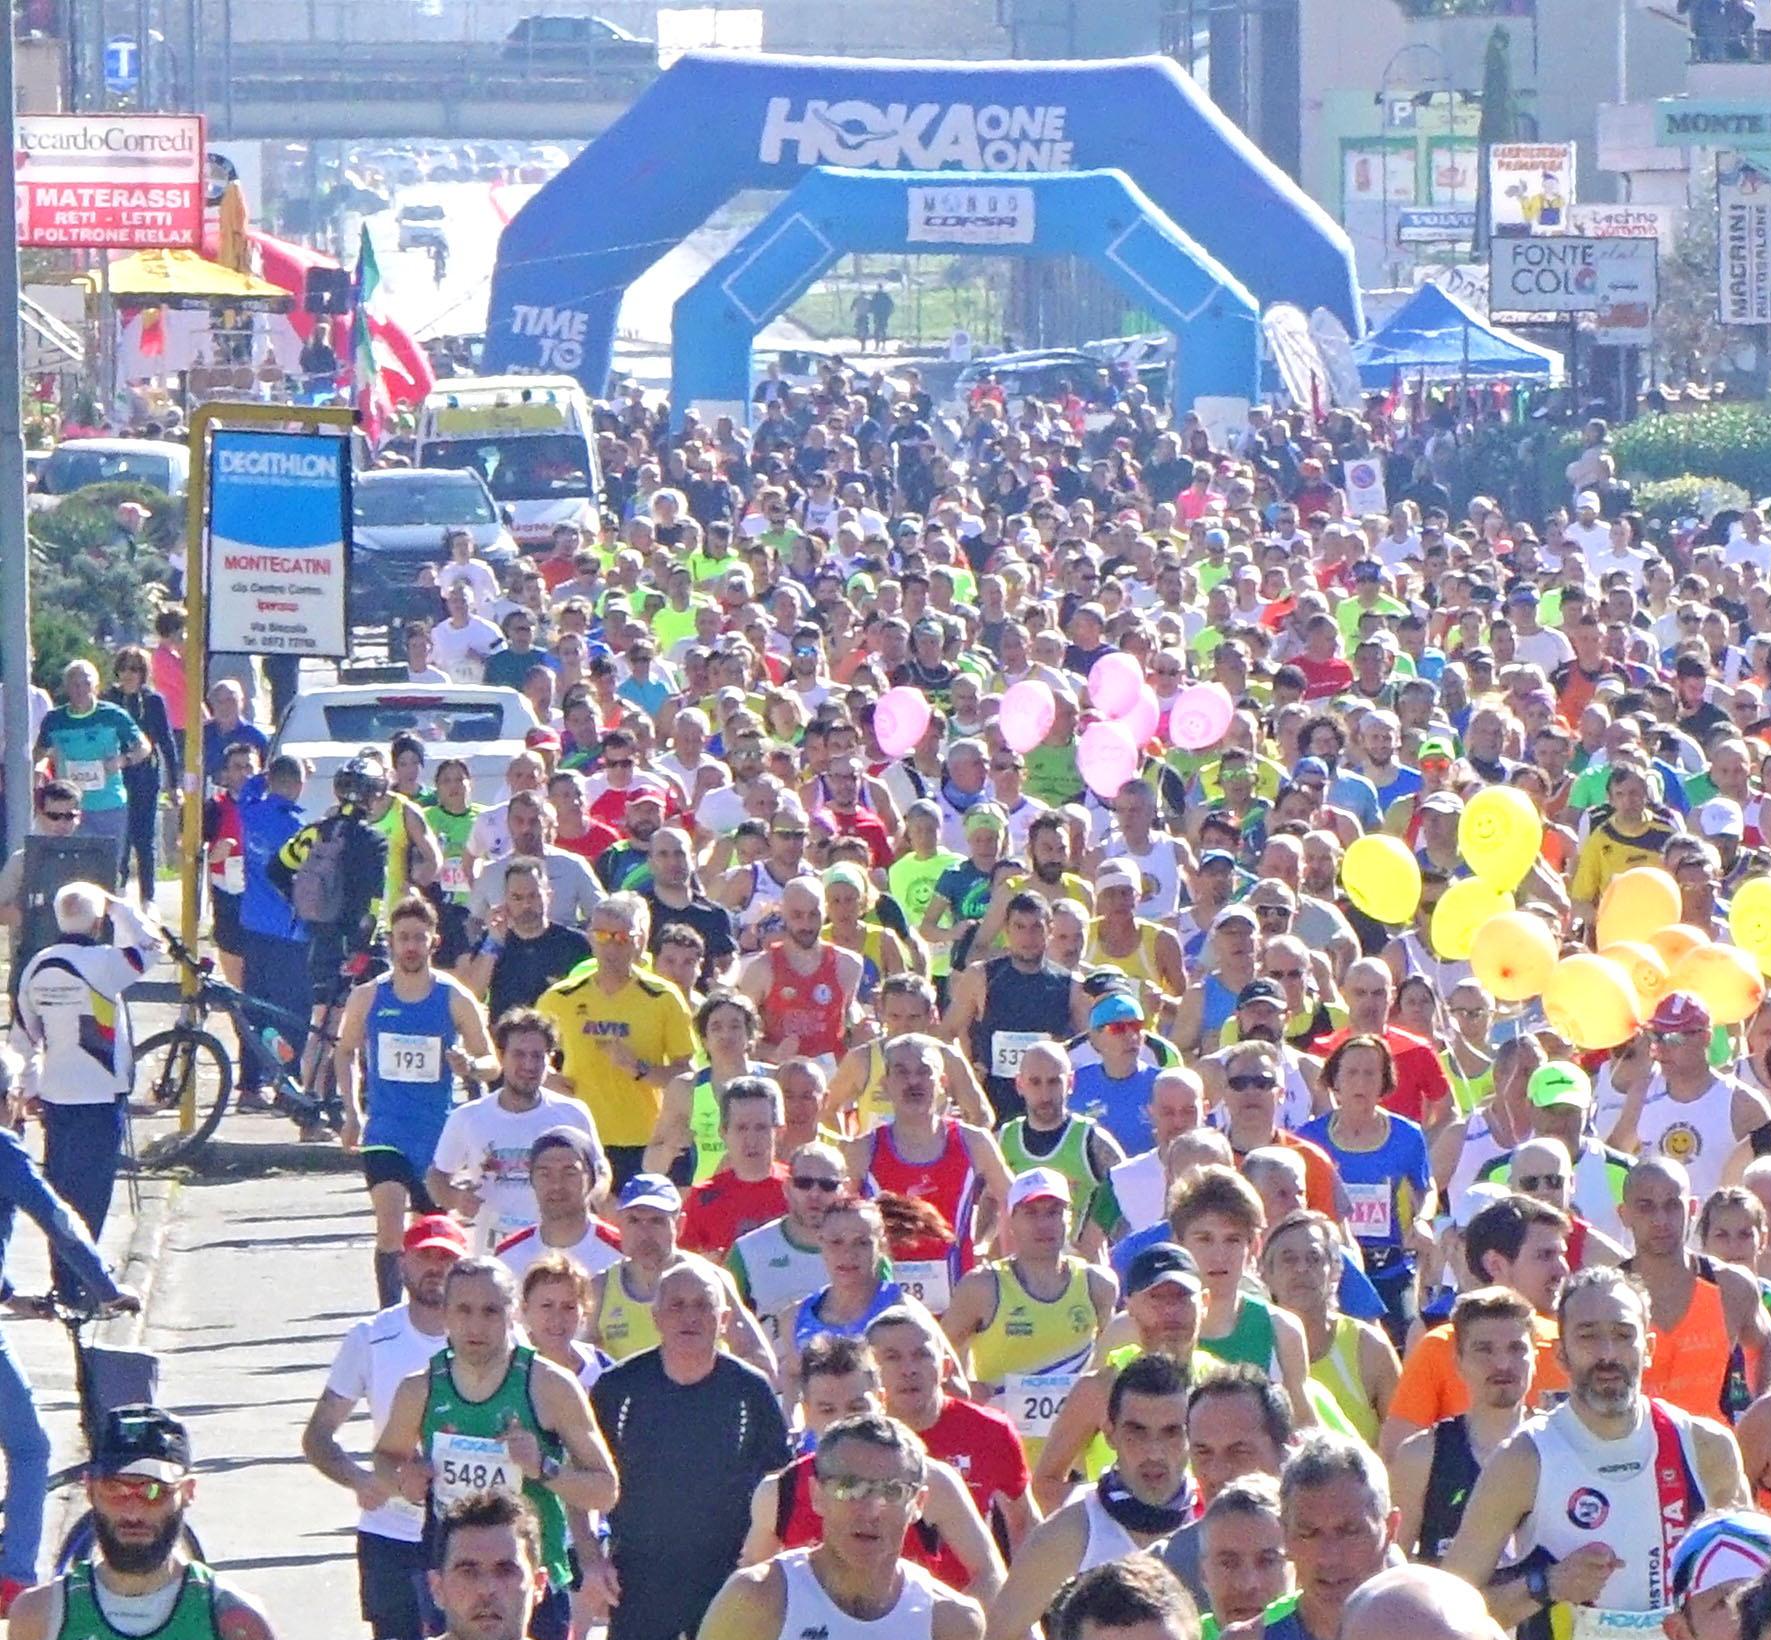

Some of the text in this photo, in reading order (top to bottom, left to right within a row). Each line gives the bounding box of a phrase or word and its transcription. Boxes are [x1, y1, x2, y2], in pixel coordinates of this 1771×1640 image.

[759, 97, 1066, 170] HOKA ONE
[1667, 113, 1762, 134] MONTE
[19, 126, 193, 151] iccardoCorredi
[982, 141, 1075, 173] ONE
[35, 188, 191, 208] MATERASSI
[55, 211, 96, 225] RETI
[121, 212, 172, 225] LETTI
[34, 228, 193, 243] POLTRONE RELAX
[1512, 245, 1593, 266] FONTE
[512, 305, 589, 341] TIME
[539, 337, 583, 371] TO
[219, 450, 336, 478] DECATHLON
[224, 556, 331, 575] MONTECATINI
[582, 1021, 630, 1037] AVIS
[393, 1051, 424, 1070] 193
[444, 1460, 507, 1488] 548A
